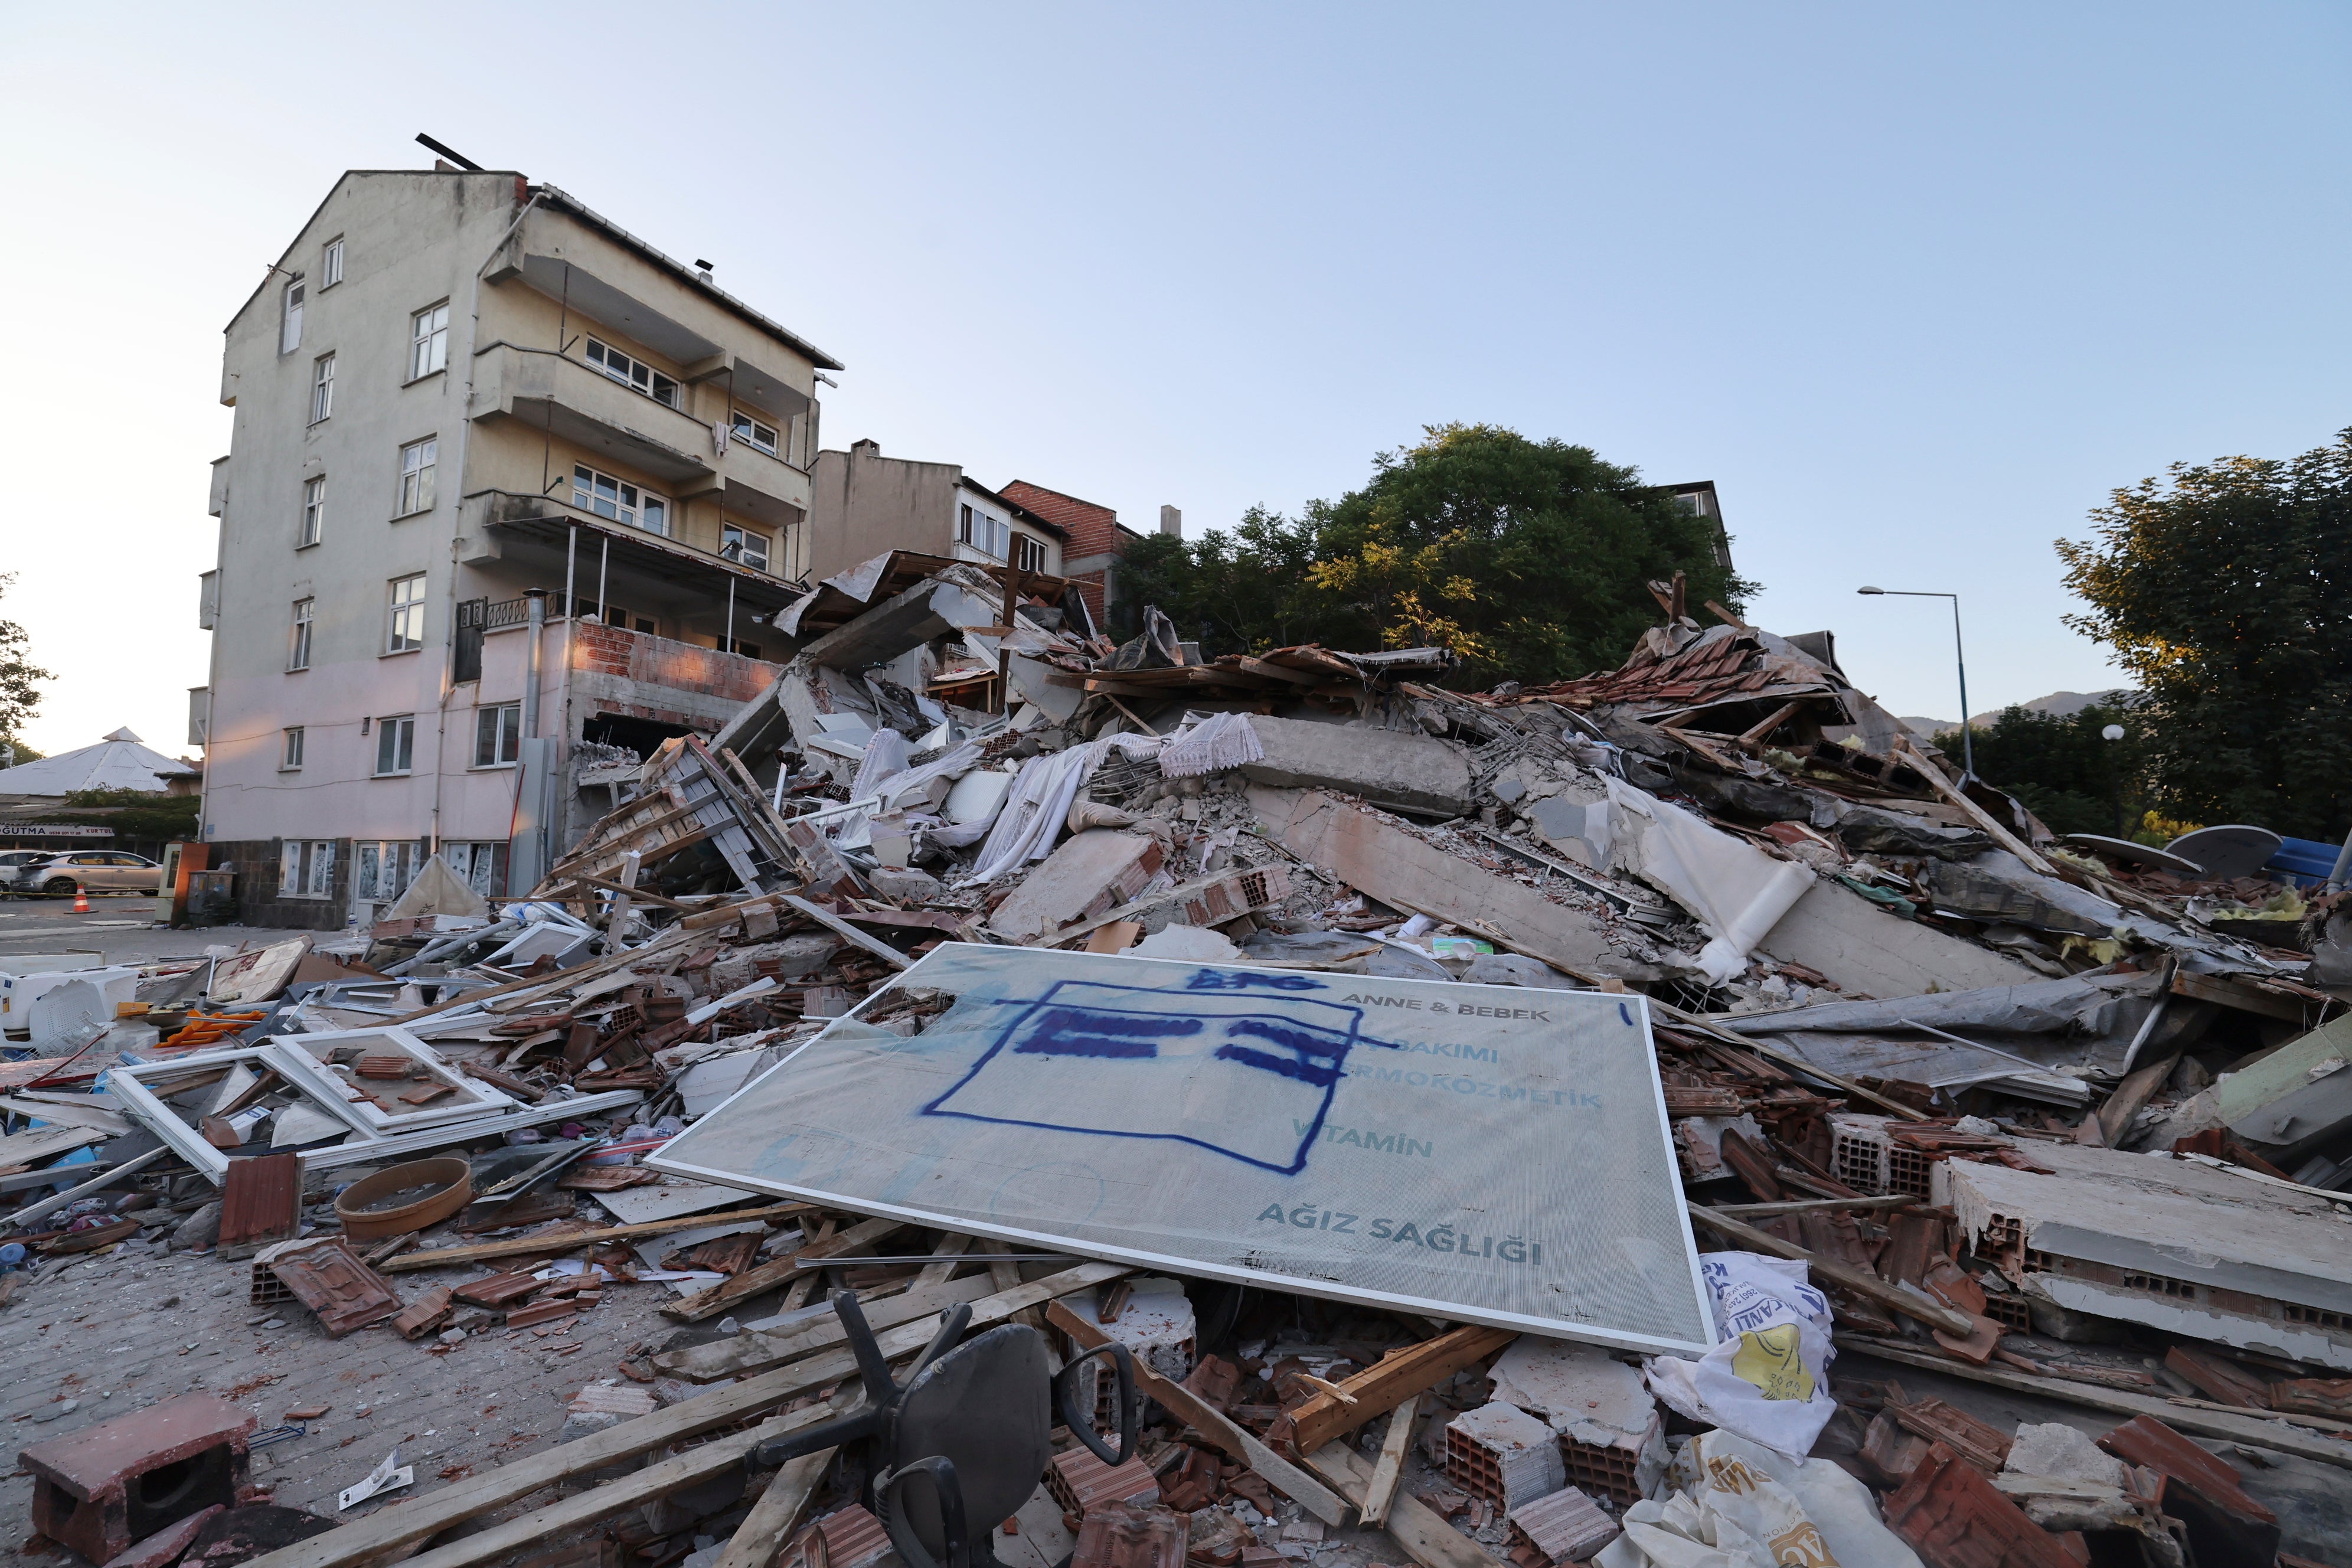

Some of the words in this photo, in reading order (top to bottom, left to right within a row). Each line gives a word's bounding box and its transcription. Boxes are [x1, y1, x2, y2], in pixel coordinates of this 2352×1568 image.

[1342, 994, 1423, 1013] ANNE
[1430, 1001, 1450, 1012] &
[1458, 1005, 1551, 1022] BEBEK
[1393, 1038, 1498, 1063] BAKIMI
[1292, 1119, 1433, 1158] VTAMİN
[1256, 1203, 1359, 1234] AĞIZ
[1369, 1218, 1542, 1265] SAĞLIĞI
[1763, 1508, 1806, 1538] ECTION
